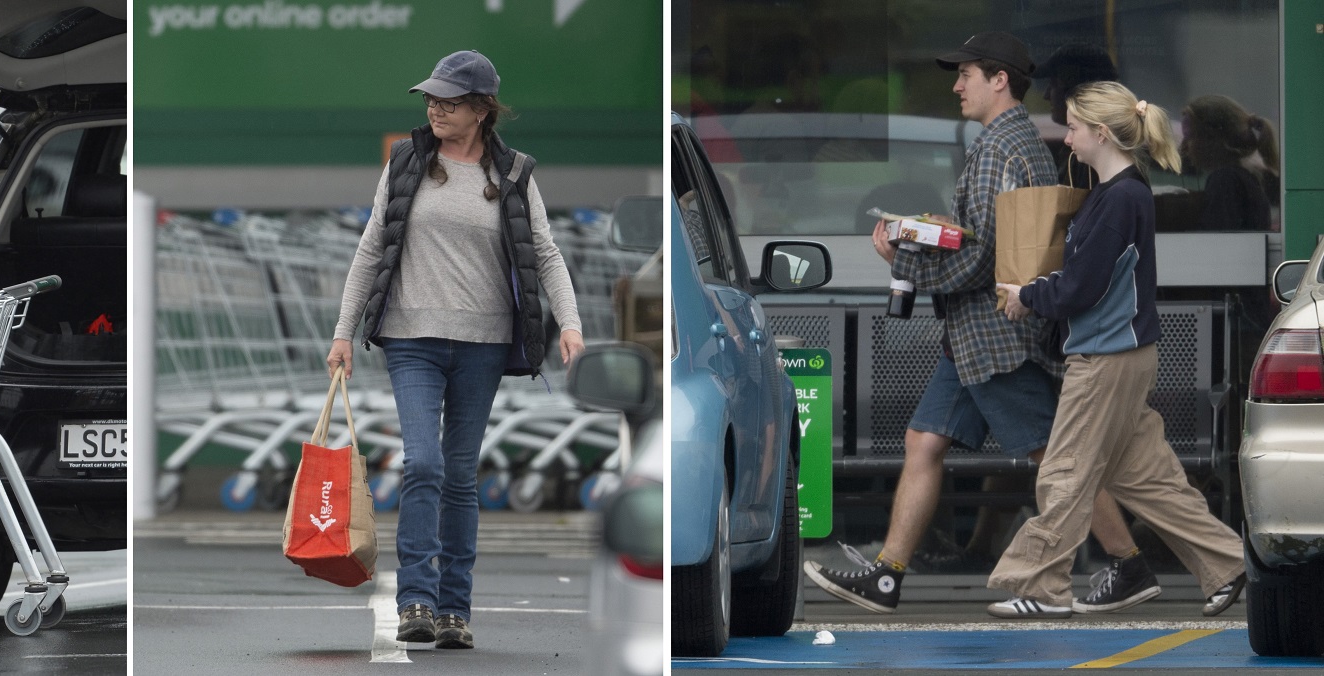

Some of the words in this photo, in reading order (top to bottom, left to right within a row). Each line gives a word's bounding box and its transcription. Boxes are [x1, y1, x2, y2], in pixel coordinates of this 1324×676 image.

[148, 3, 219, 37] your
[224, 0, 324, 29] online
[327, 0, 411, 29] order
[320, 481, 332, 518] Rural
